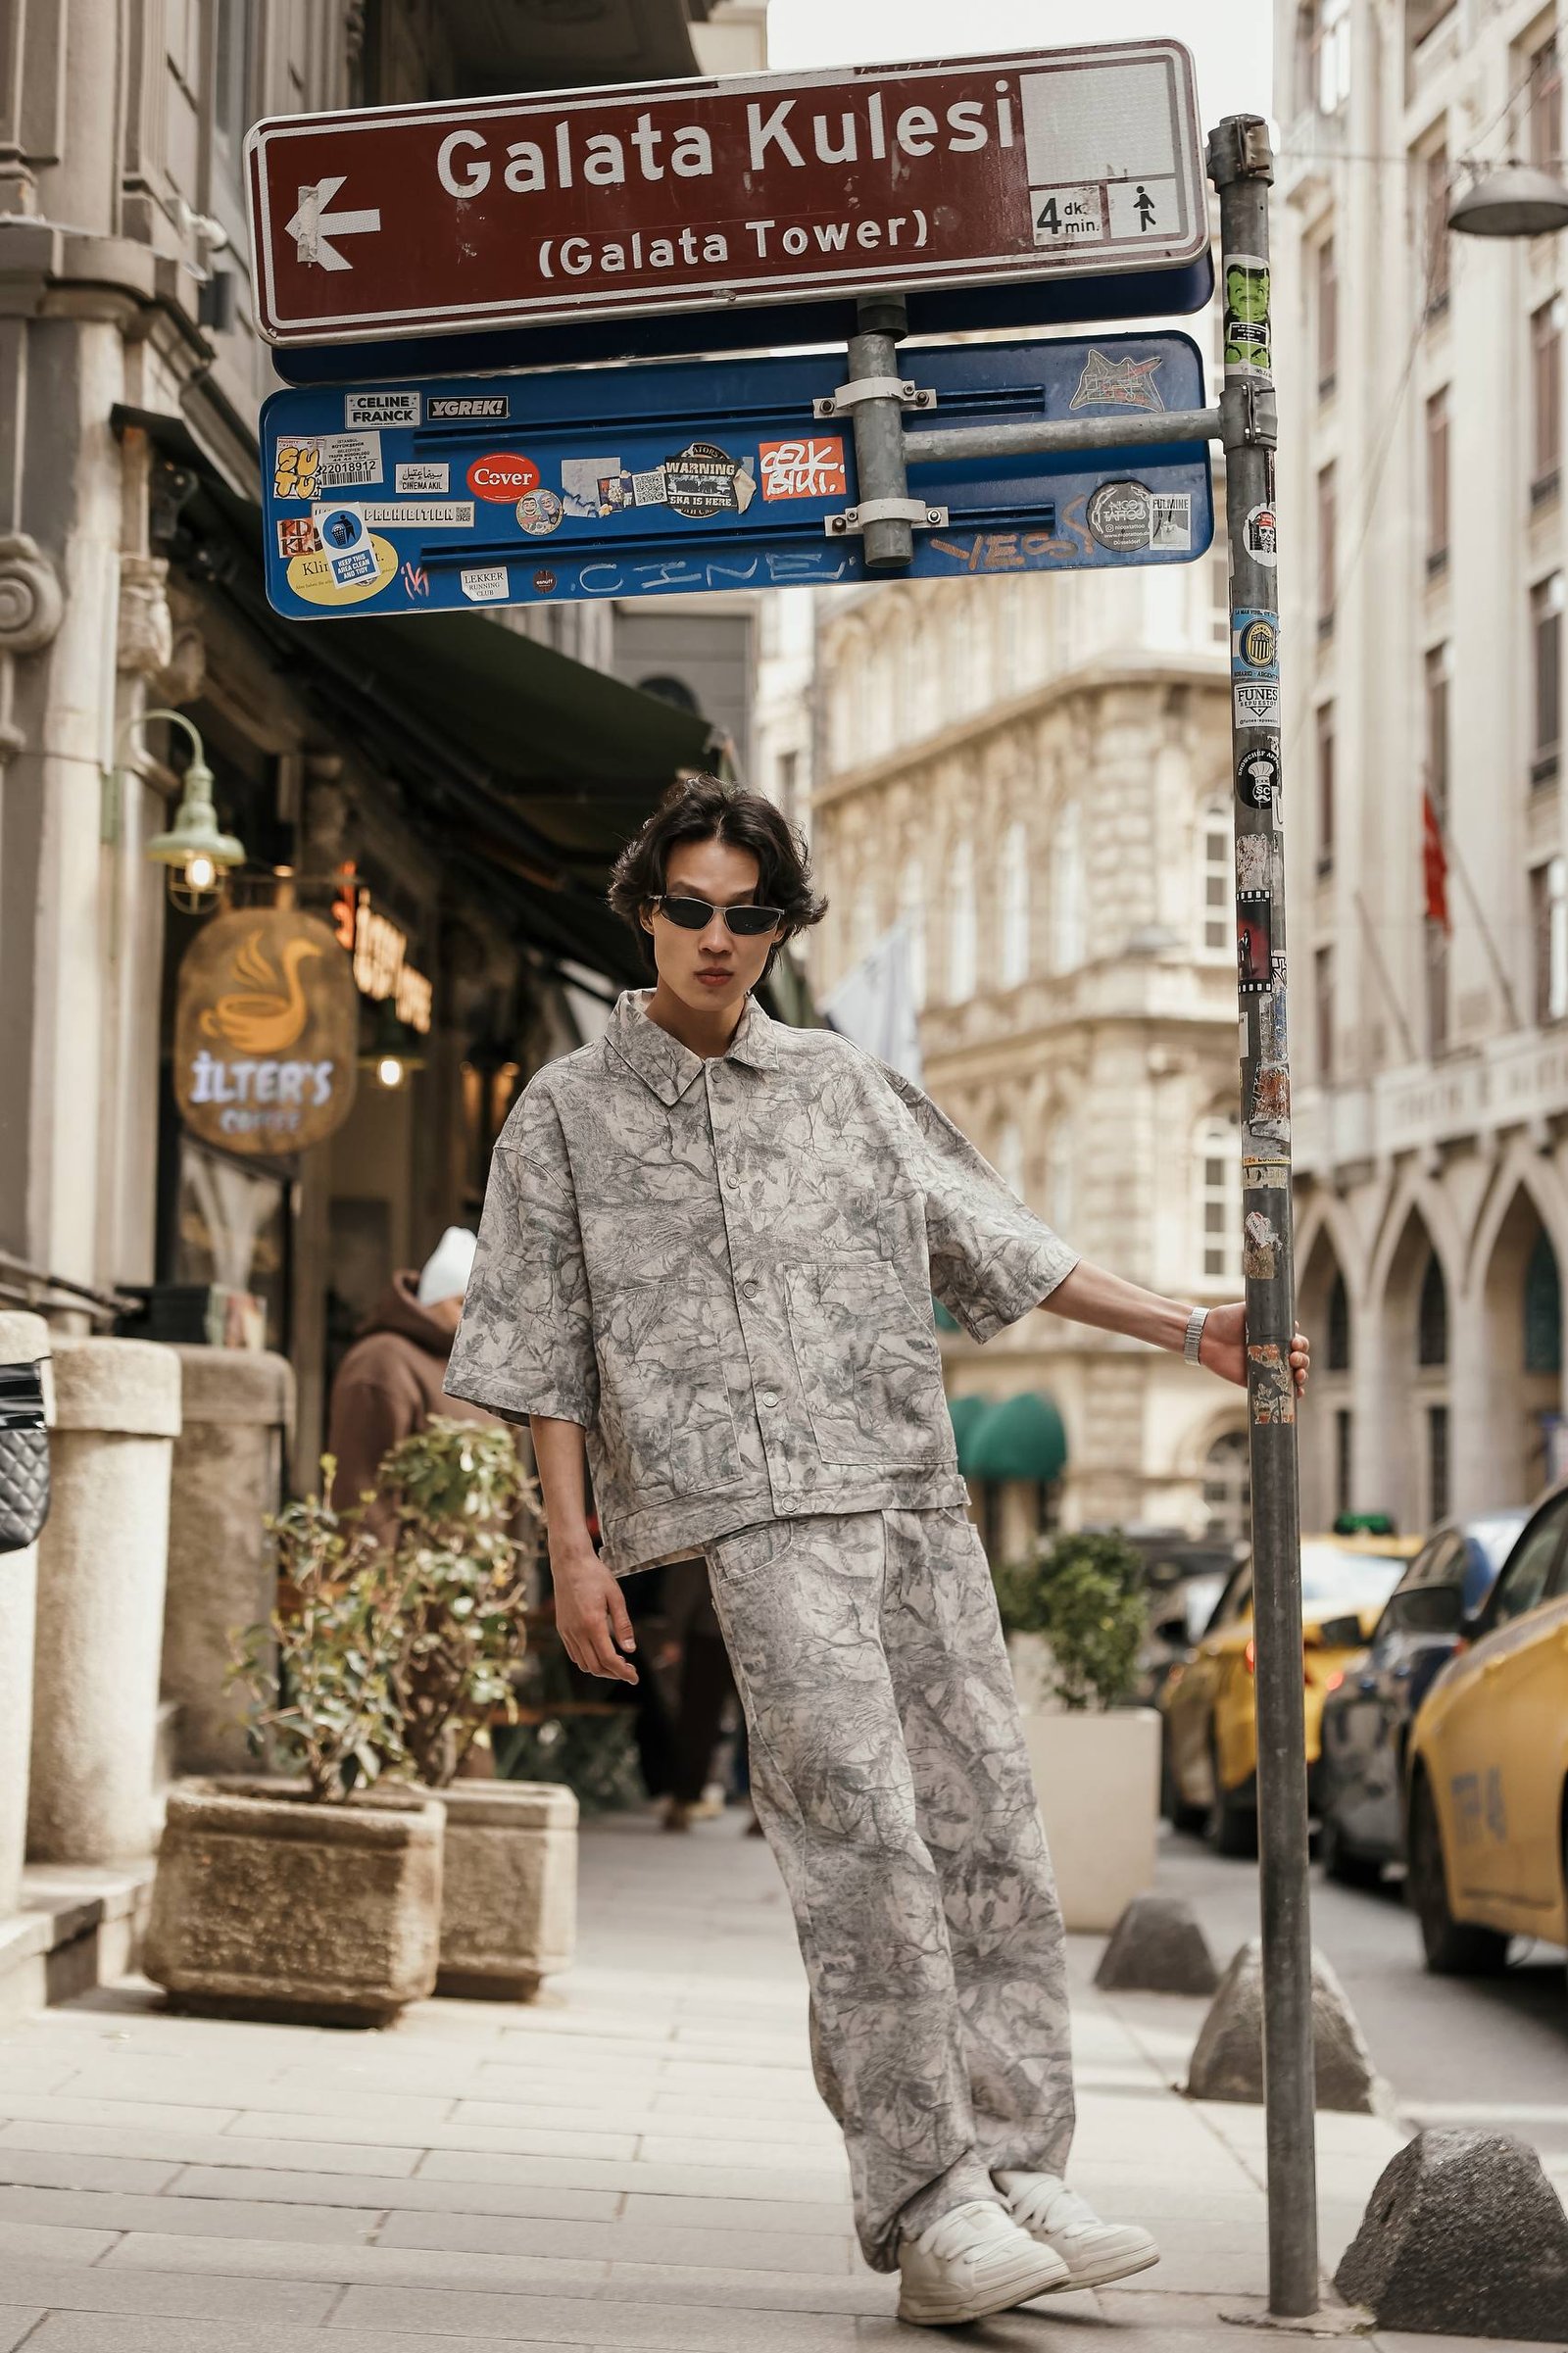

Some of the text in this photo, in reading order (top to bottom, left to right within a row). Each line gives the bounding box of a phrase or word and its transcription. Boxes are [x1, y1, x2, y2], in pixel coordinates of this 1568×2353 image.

[437, 79, 1014, 198] Galata Kulesi
[1037, 198, 1062, 234] 4
[1065, 220, 1100, 233] min.
[539, 209, 929, 278] (Galata Tower)
[357, 396, 410, 408] CELINE
[432, 400, 504, 417] YGREK!
[353, 411, 414, 422] FRANCK
[665, 462, 735, 474] WARNING
[474, 467, 532, 486] Cover
[402, 481, 443, 490] CINEMA AKIL
[364, 509, 454, 521] PROHIBITION
[338, 558, 353, 567] KEEP
[352, 553, 367, 563] THIS
[337, 559, 370, 575] AREA CLEAN
[343, 565, 368, 580] AND TIDY
[465, 571, 504, 584] LEKKER
[468, 581, 501, 591] RUNNING
[476, 589, 495, 598] CLUB
[1238, 688, 1278, 703] FUNES
[1255, 785, 1271, 796] SC
